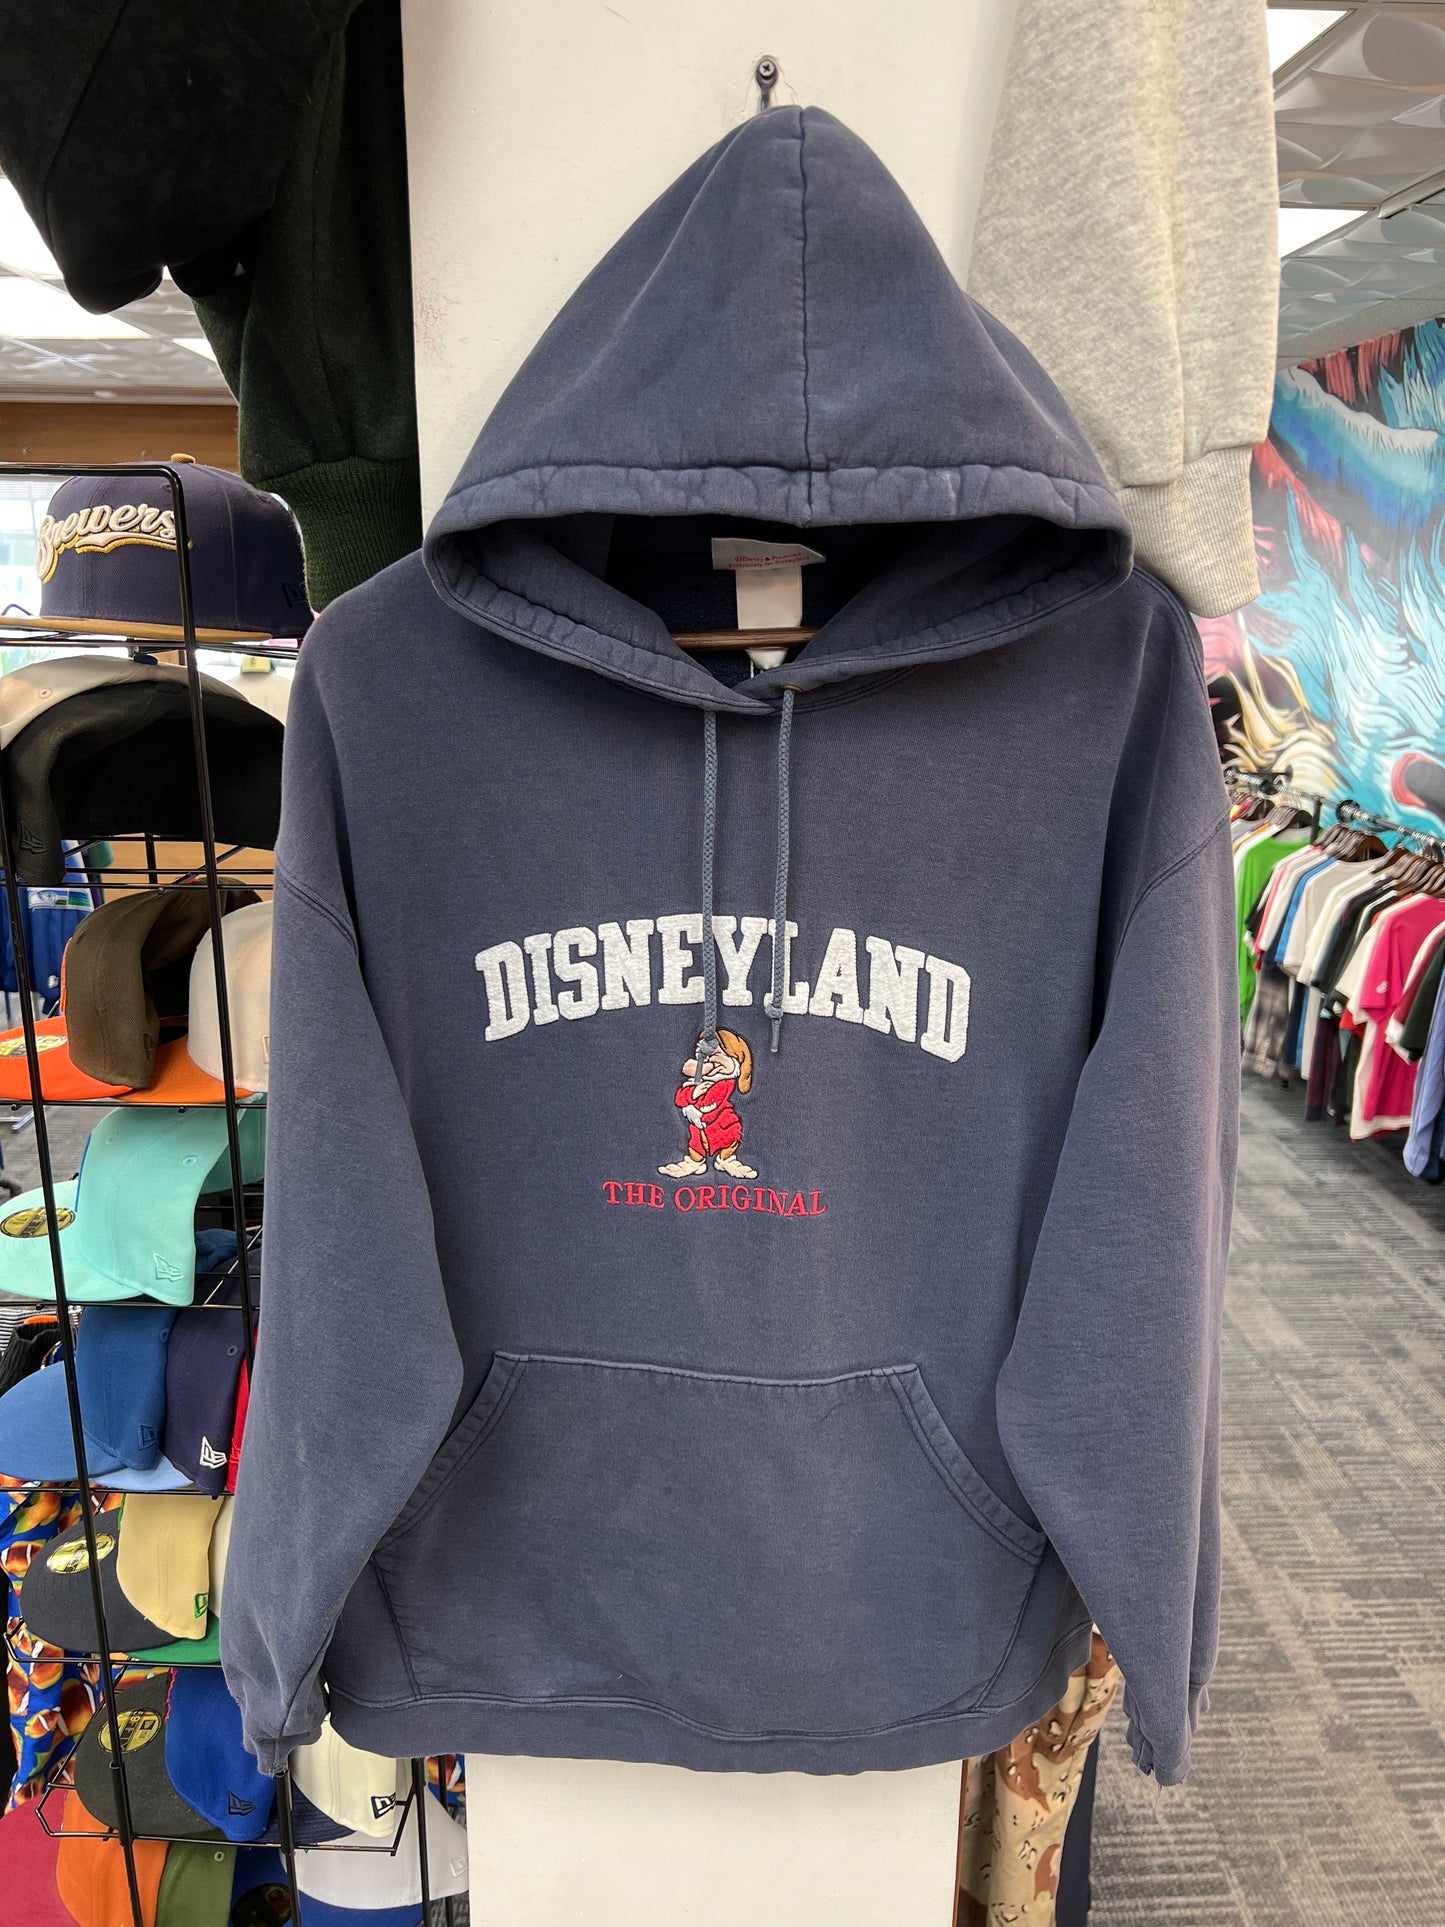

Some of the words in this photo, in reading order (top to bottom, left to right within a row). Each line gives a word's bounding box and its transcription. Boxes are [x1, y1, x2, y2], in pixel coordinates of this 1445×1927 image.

[36, 503, 178, 583] Brewers
[475, 913, 972, 1064] DISNEYLAND
[602, 1181, 665, 1209] THE
[674, 1185, 828, 1217] ORIGINAL
